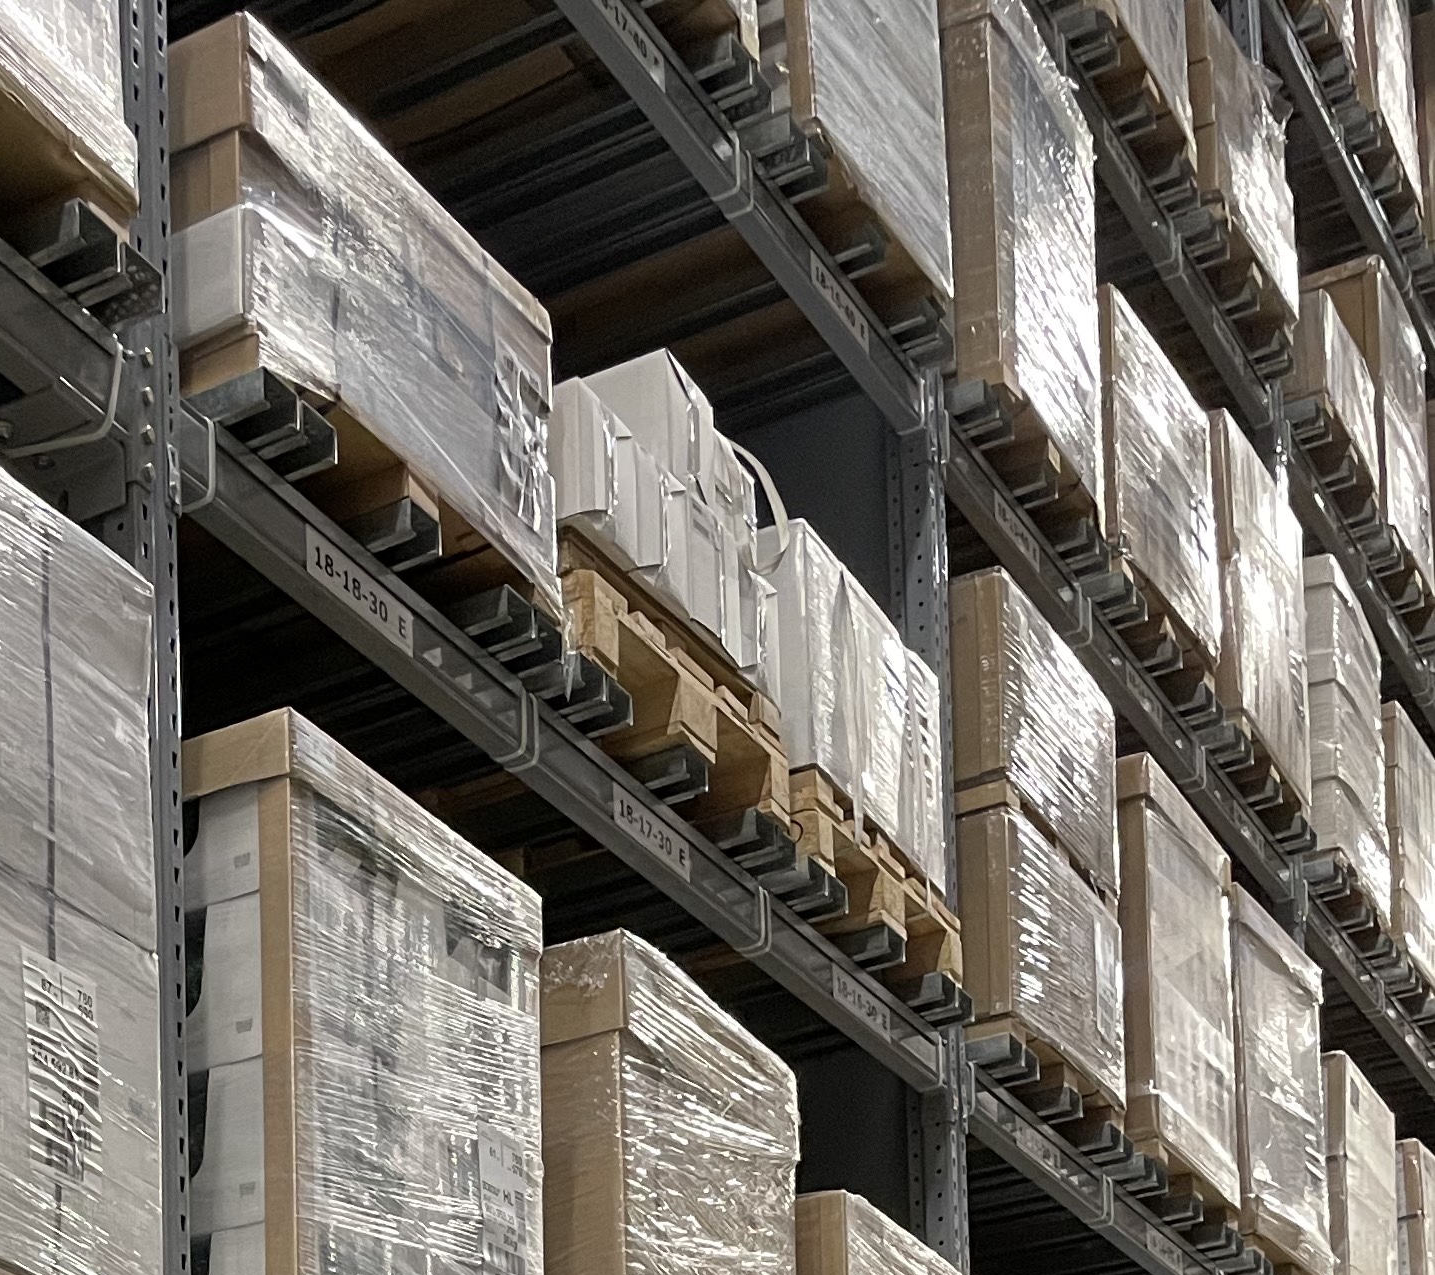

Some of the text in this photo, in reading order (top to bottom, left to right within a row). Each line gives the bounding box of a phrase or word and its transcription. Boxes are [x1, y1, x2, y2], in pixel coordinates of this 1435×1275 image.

[314, 545, 407, 640] 18-18-30 E
[619, 799, 686, 867] 18-17-30 E
